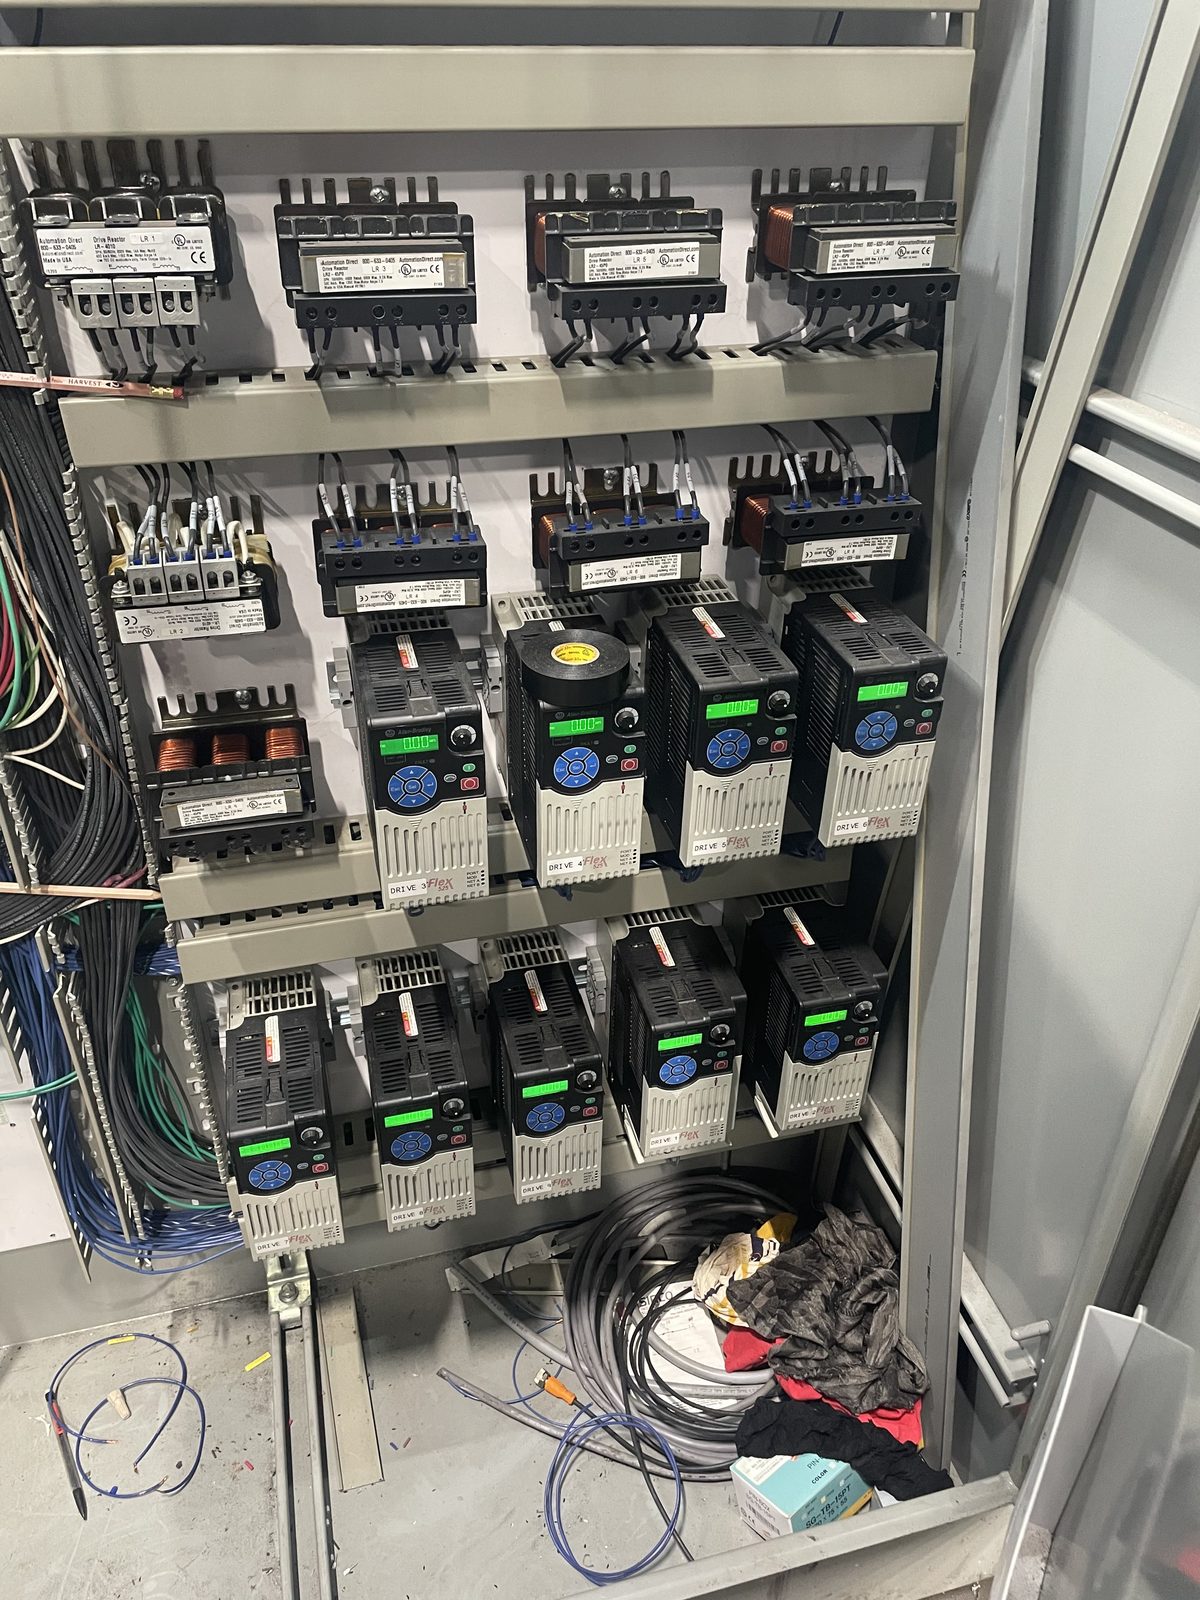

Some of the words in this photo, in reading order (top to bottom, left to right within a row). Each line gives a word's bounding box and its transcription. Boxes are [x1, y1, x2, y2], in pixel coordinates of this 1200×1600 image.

[836, 822, 859, 831] DRIVE
[695, 843, 717, 851] DRIVE
[549, 862, 573, 870] DRIVE
[390, 885, 416, 894] DRIVE
[651, 1137, 670, 1145] DRIVE
[523, 1185, 543, 1193] DRIVE
[394, 1212, 415, 1220] DRIVE
[258, 1242, 280, 1250] DRIVE
[812, 1469, 828, 1484] COLOR
